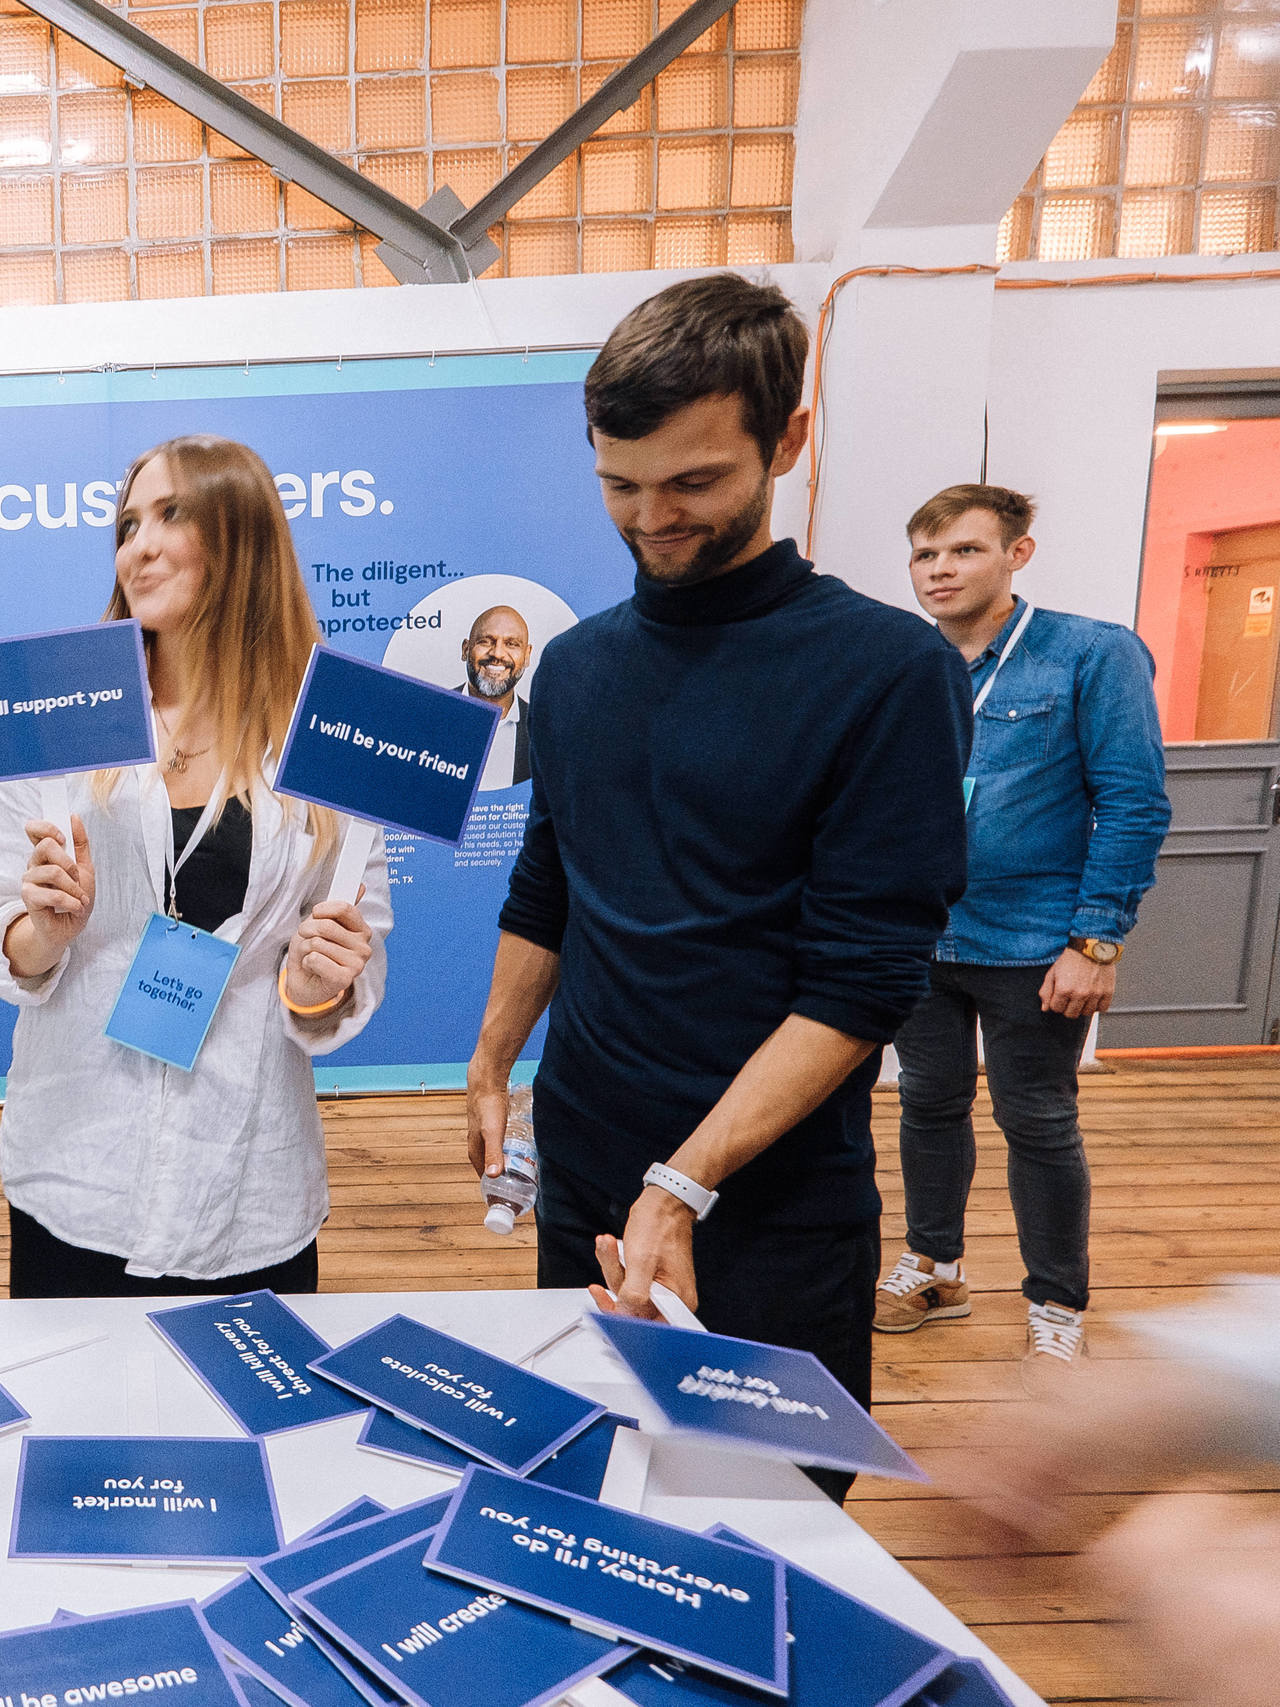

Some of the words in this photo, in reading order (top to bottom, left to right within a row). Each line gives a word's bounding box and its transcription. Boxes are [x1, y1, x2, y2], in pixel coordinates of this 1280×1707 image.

[311, 563, 354, 583] The
[361, 560, 464, 585] diligent...
[331, 588, 371, 608] but
[317, 609, 442, 638] nprotected
[12, 691, 86, 715] support
[88, 688, 123, 707] you
[309, 713, 318, 730] I
[319, 721, 352, 741] will
[352, 728, 375, 749] be
[375, 740, 417, 762] your
[418, 750, 469, 780] friend
[138, 979, 196, 1013] together.
[185, 985, 203, 1000] go
[213, 1321, 248, 1351] every
[232, 1317, 261, 1338] you
[251, 1337, 275, 1355] for
[238, 1351, 265, 1370] kill
[255, 1369, 286, 1393] will
[268, 1354, 312, 1396] threat
[380, 1355, 467, 1400] calculate
[424, 1362, 465, 1384] you
[460, 1381, 493, 1400] for
[463, 1397, 505, 1421] will
[103, 1475, 146, 1490] you
[149, 1479, 185, 1494] for
[72, 1495, 157, 1512] market
[162, 1496, 205, 1512] will
[479, 1506, 531, 1531] you
[511, 1533, 550, 1554] do
[532, 1524, 578, 1548] for
[583, 1537, 751, 1604] everything
[597, 1558, 702, 1610] Honey,
[397, 1621, 443, 1655] will
[438, 1593, 508, 1634] create
[63, 1666, 198, 1706] awesome
